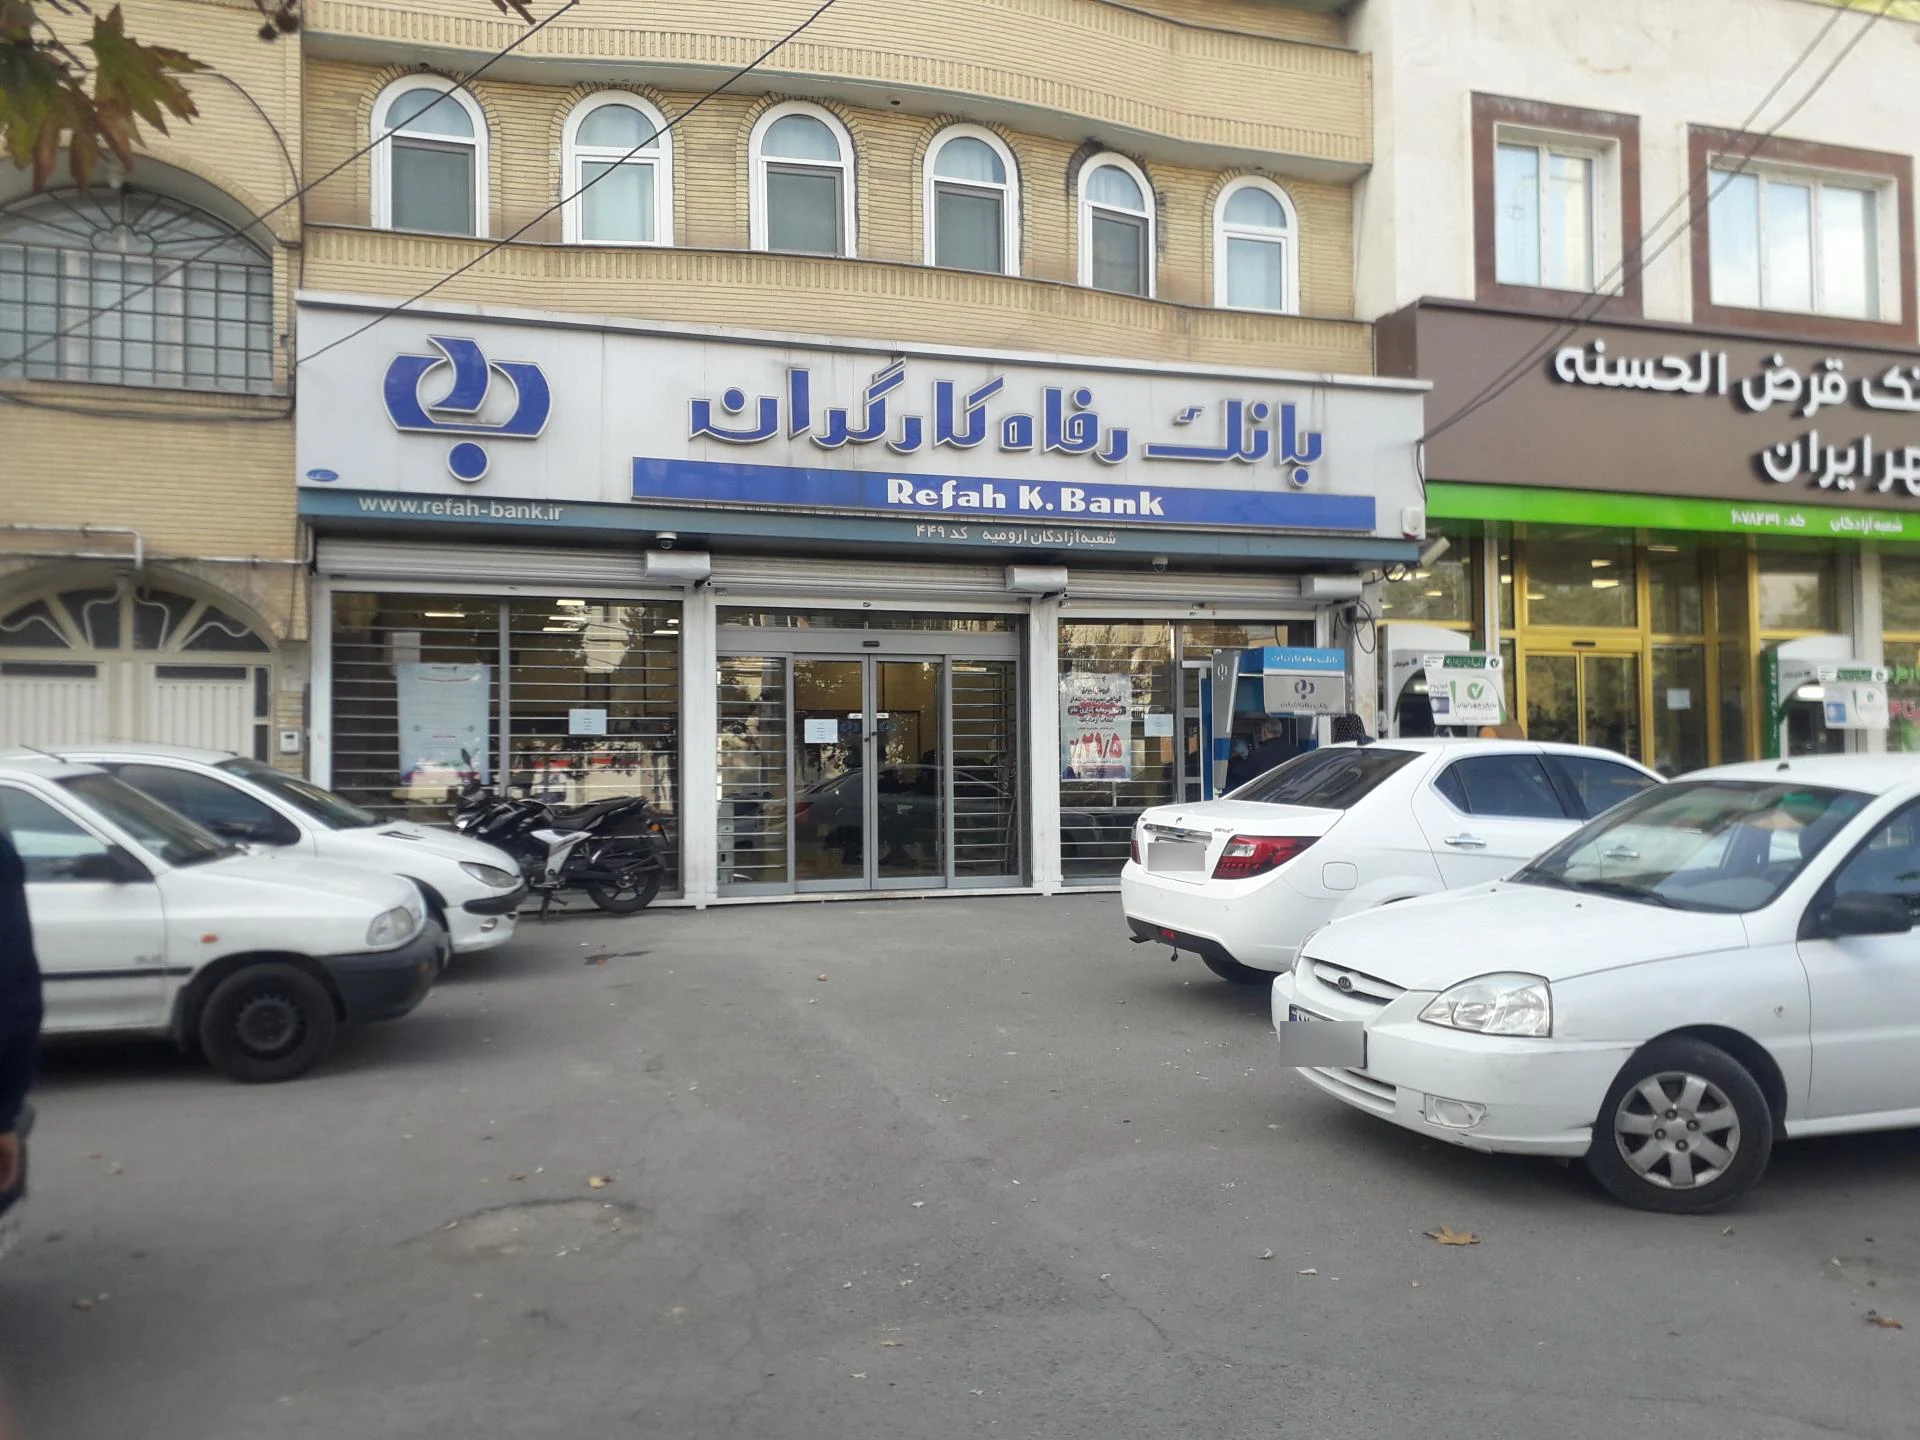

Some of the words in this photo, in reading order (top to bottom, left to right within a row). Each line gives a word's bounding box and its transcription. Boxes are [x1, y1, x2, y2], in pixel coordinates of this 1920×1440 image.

[1554, 338, 1728, 396] الحسنه
[1742, 352, 1848, 417] قرض
[687, 356, 1006, 450] کارگران
[998, 385, 1131, 465] رفاه
[1143, 399, 1324, 489] بانک
[1762, 428, 1873, 493] ایران
[1878, 445, 1920, 498] هر
[358, 496, 563, 521] www.refah-bank.ir
[887, 478, 1006, 510] Refah
[1018, 485, 1054, 512] K.
[1060, 487, 1165, 517] Bank
[950, 526, 969, 540] کد
[982, 528, 1028, 545] ارومیه
[1080, 531, 1117, 548] شعبه
